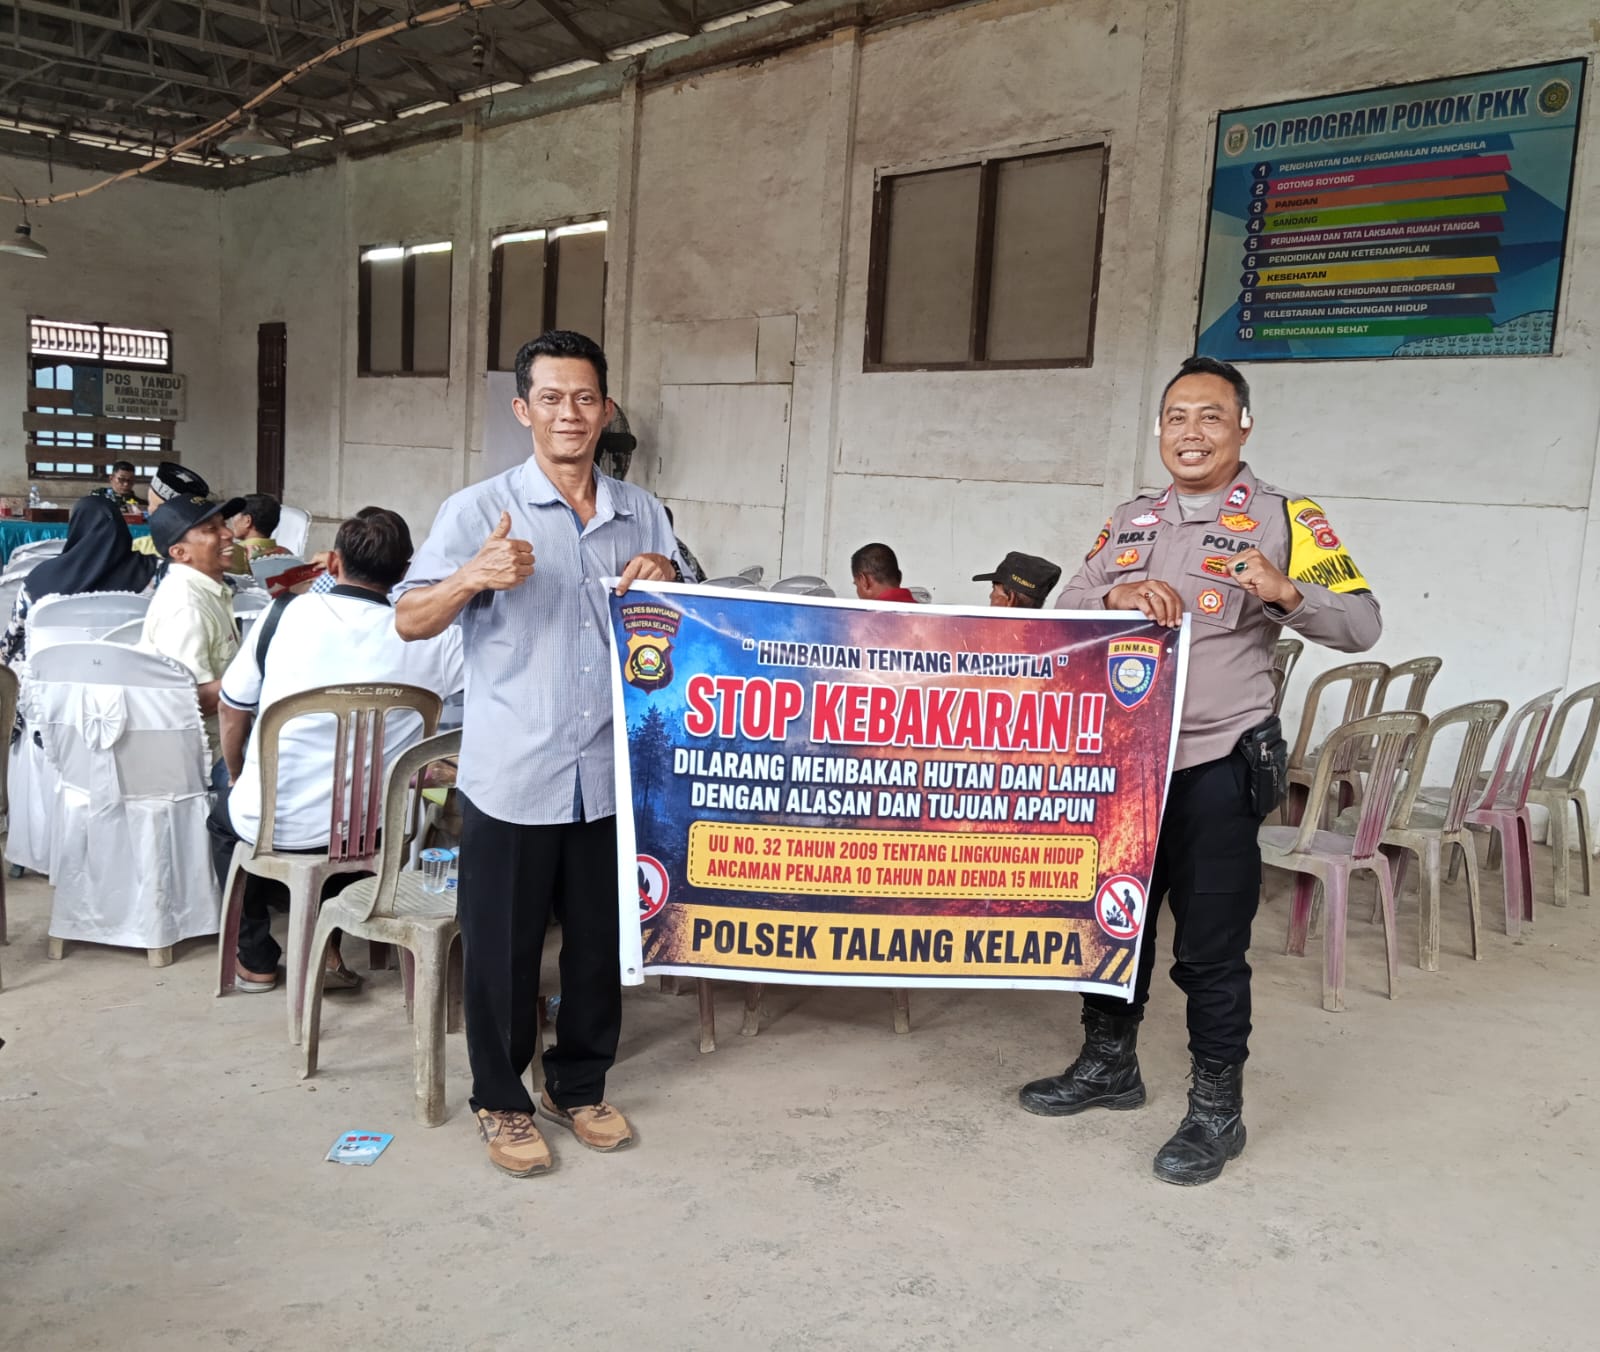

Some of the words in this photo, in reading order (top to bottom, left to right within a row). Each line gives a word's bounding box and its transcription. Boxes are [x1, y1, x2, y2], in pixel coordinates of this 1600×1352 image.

[1253, 120, 1278, 151] 10
[1279, 105, 1389, 147] PROGRAM
[1390, 92, 1475, 133] POKOK
[1475, 84, 1531, 122] PKK
[1259, 165, 1266, 176] 1
[1280, 155, 1340, 172] PENGHAYATAN
[1343, 155, 1362, 164] DAN
[1363, 147, 1428, 162] PENGAMALAN
[1431, 140, 1486, 153] PANCASILA
[1255, 183, 1264, 195] 2
[1277, 179, 1314, 190] GOTONG
[1316, 174, 1354, 186] ROYONG
[1254, 202, 1261, 213] 3
[1275, 197, 1317, 208] PANGAN
[1251, 220, 1259, 231] 4
[1273, 216, 1317, 227] SANDANG
[1250, 239, 1257, 249] 5
[1271, 234, 1320, 245] PERUMAHAN
[1323, 232, 1340, 241] DAN
[1343, 230, 1362, 239] TATA
[1364, 226, 1404, 238] LAKSANA
[1407, 223, 1440, 234] RUMAH
[1442, 221, 1480, 231] TANGGA
[1248, 256, 1256, 267] 6
[1269, 252, 1325, 263] PENDIDIKAN
[1328, 249, 1348, 259] DAN
[1351, 244, 1430, 257] KETERAMPILAN
[1247, 274, 1254, 285] 7
[1267, 270, 1327, 281] KESEHATAN
[1244, 292, 1252, 302] 8
[1265, 288, 1335, 300] PENGEMBANGAN
[1337, 286, 1388, 296] KEHIDUPAN
[1391, 282, 1455, 293] BERKOPERASI
[1243, 310, 1251, 320] 9
[1264, 308, 1325, 318] KELESTARIAN
[1328, 305, 1392, 316] LINGKUNGAN
[1395, 303, 1428, 312] HIDUP
[1239, 328, 1253, 338] 10
[1263, 327, 1334, 336] PERENCANAAN
[1336, 325, 1369, 333] SEHAT
[105, 373, 131, 386] POS
[141, 376, 181, 390] YANDU
[1147, 531, 1157, 541] S
[622, 606, 645, 616] POLRES
[653, 621, 676, 634] SELATAN
[1114, 641, 1155, 654] BINMAS
[759, 641, 860, 669] HIMBAUAN
[867, 648, 951, 674] TENTANG
[957, 652, 1053, 679] KARHUTLA
[686, 675, 803, 741] STOP
[811, 681, 1072, 752] KEBAKARAN
[674, 748, 785, 782] DILARANG
[791, 756, 918, 787] MEMBAKAR
[924, 762, 994, 790] HUTAN
[1000, 764, 1042, 791] DAN
[1049, 766, 1116, 793] LAHAN
[691, 782, 780, 812] DENGAN
[786, 788, 872, 817] ALASAN
[878, 792, 921, 818] DAN
[928, 794, 1008, 821] TUJUAN
[1013, 797, 1095, 823] APAPUN
[709, 834, 728, 853] UU
[734, 836, 758, 856] NO.
[763, 838, 781, 856] 32
[786, 839, 835, 859] TAHUN
[840, 841, 877, 861] 2009
[883, 842, 947, 863] TENTANG
[951, 844, 1039, 865] LINGKUNGAN
[1043, 847, 1084, 866] HIDUP
[707, 859, 780, 881] ANCAMAN
[786, 864, 851, 884] PENJARA
[856, 867, 871, 885] 10
[876, 867, 923, 887] TAHUN
[927, 869, 957, 888] DAN
[961, 870, 1007, 888] DENDA
[1011, 871, 1025, 888] 15
[1029, 871, 1078, 889] MILYAR
[692, 917, 817, 959] POLSEK
[829, 926, 954, 963] TALANG
[963, 930, 1083, 965] KELAPA
